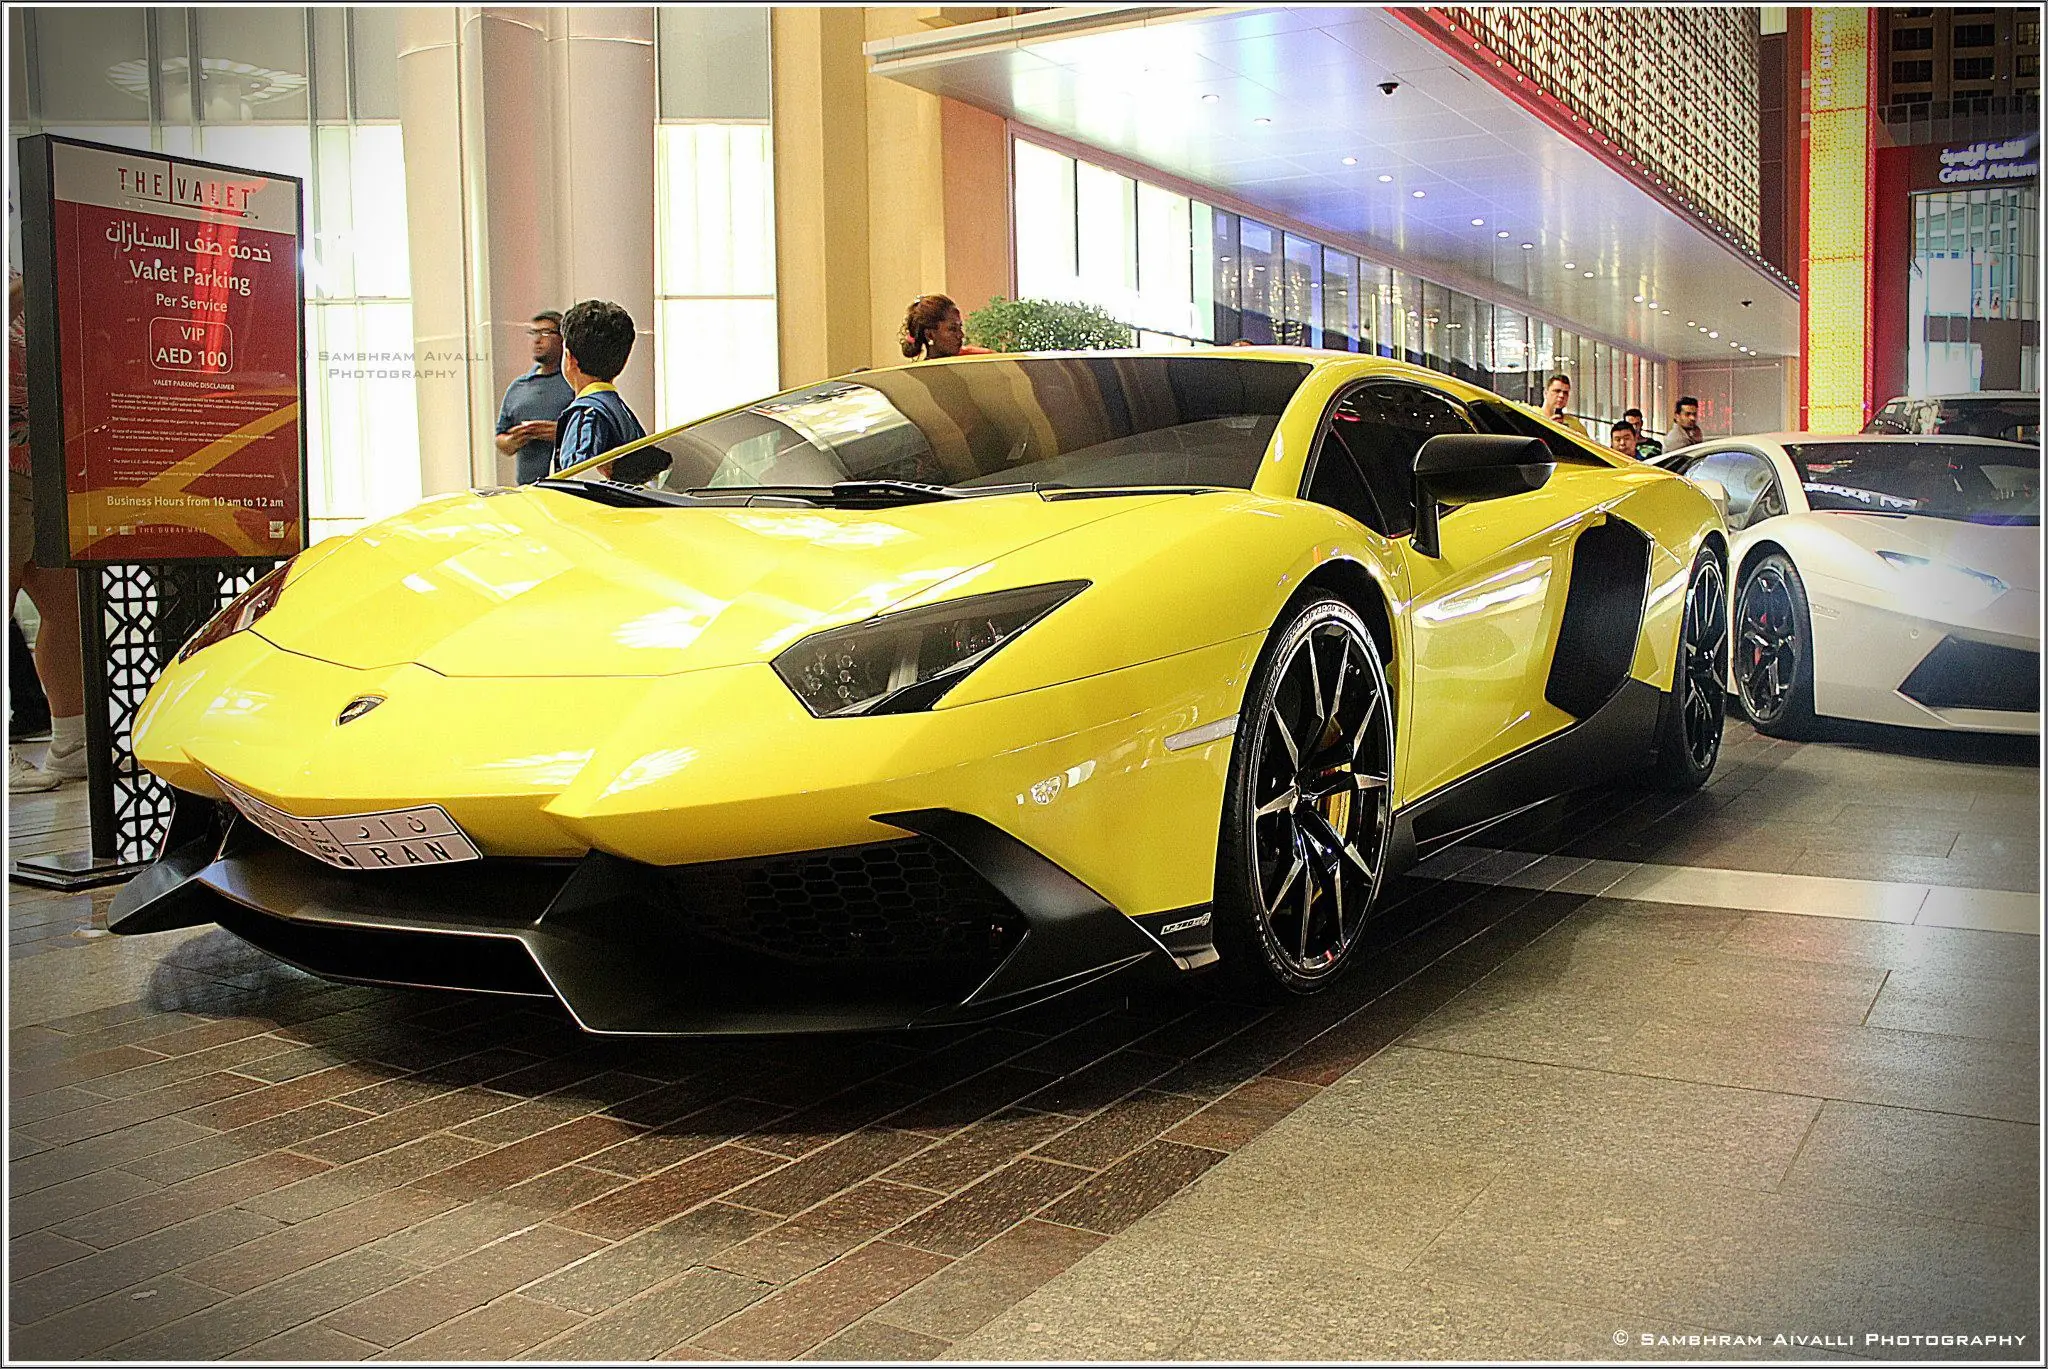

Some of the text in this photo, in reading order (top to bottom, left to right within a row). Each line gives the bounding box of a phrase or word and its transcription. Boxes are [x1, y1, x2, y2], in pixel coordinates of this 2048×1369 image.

[1939, 163, 2037, 183] Grand Atrium
[117, 167, 250, 210] THE VALET
[228, 238, 272, 263] خدمة
[129, 259, 252, 296] Valet Parking
[156, 293, 228, 313] Per Service
[180, 326, 205, 341] VIP
[155, 347, 227, 367] AED 100
[173, 380, 200, 388] PARKING
[200, 382, 235, 391] DISCLAIMER
[107, 495, 284, 508] Business Hours from 10 am to 12 am
